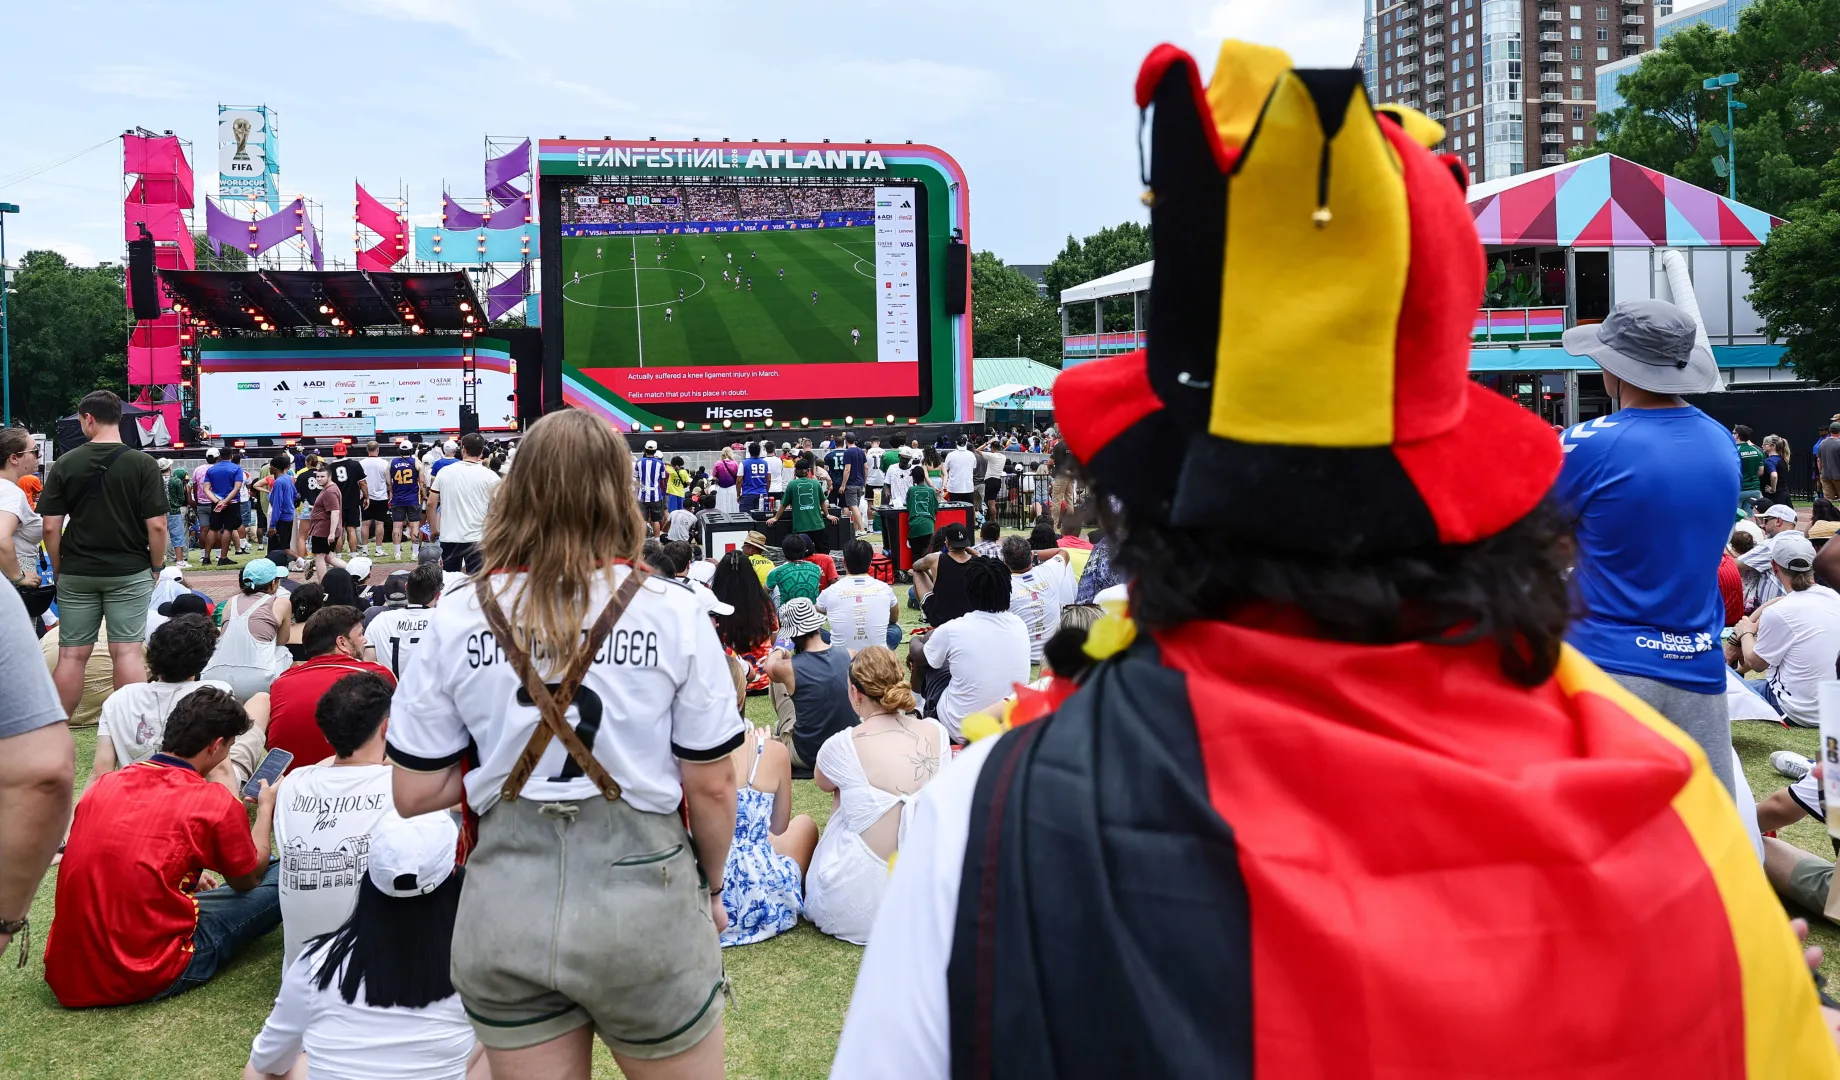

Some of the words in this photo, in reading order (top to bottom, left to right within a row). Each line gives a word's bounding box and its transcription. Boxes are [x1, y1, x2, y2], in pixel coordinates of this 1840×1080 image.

[578, 147, 586, 167] FIFA
[745, 150, 886, 169] ATLANTA
[231, 163, 253, 171] FIFA
[704, 371, 732, 380] ligament
[732, 371, 751, 379] injury
[665, 390, 679, 398] that
[702, 389, 720, 398] place
[705, 406, 773, 419] Hisense
[335, 466, 348, 482] 9
[750, 463, 765, 474] 99
[394, 468, 413, 485] 42
[397, 619, 429, 631] MÜLLER
[1661, 631, 1692, 645] Islas
[516, 683, 603, 783] 7
[289, 794, 332, 814] ADIDAS
[332, 793, 386, 814] HOUSE
[311, 809, 338, 834] Paris
